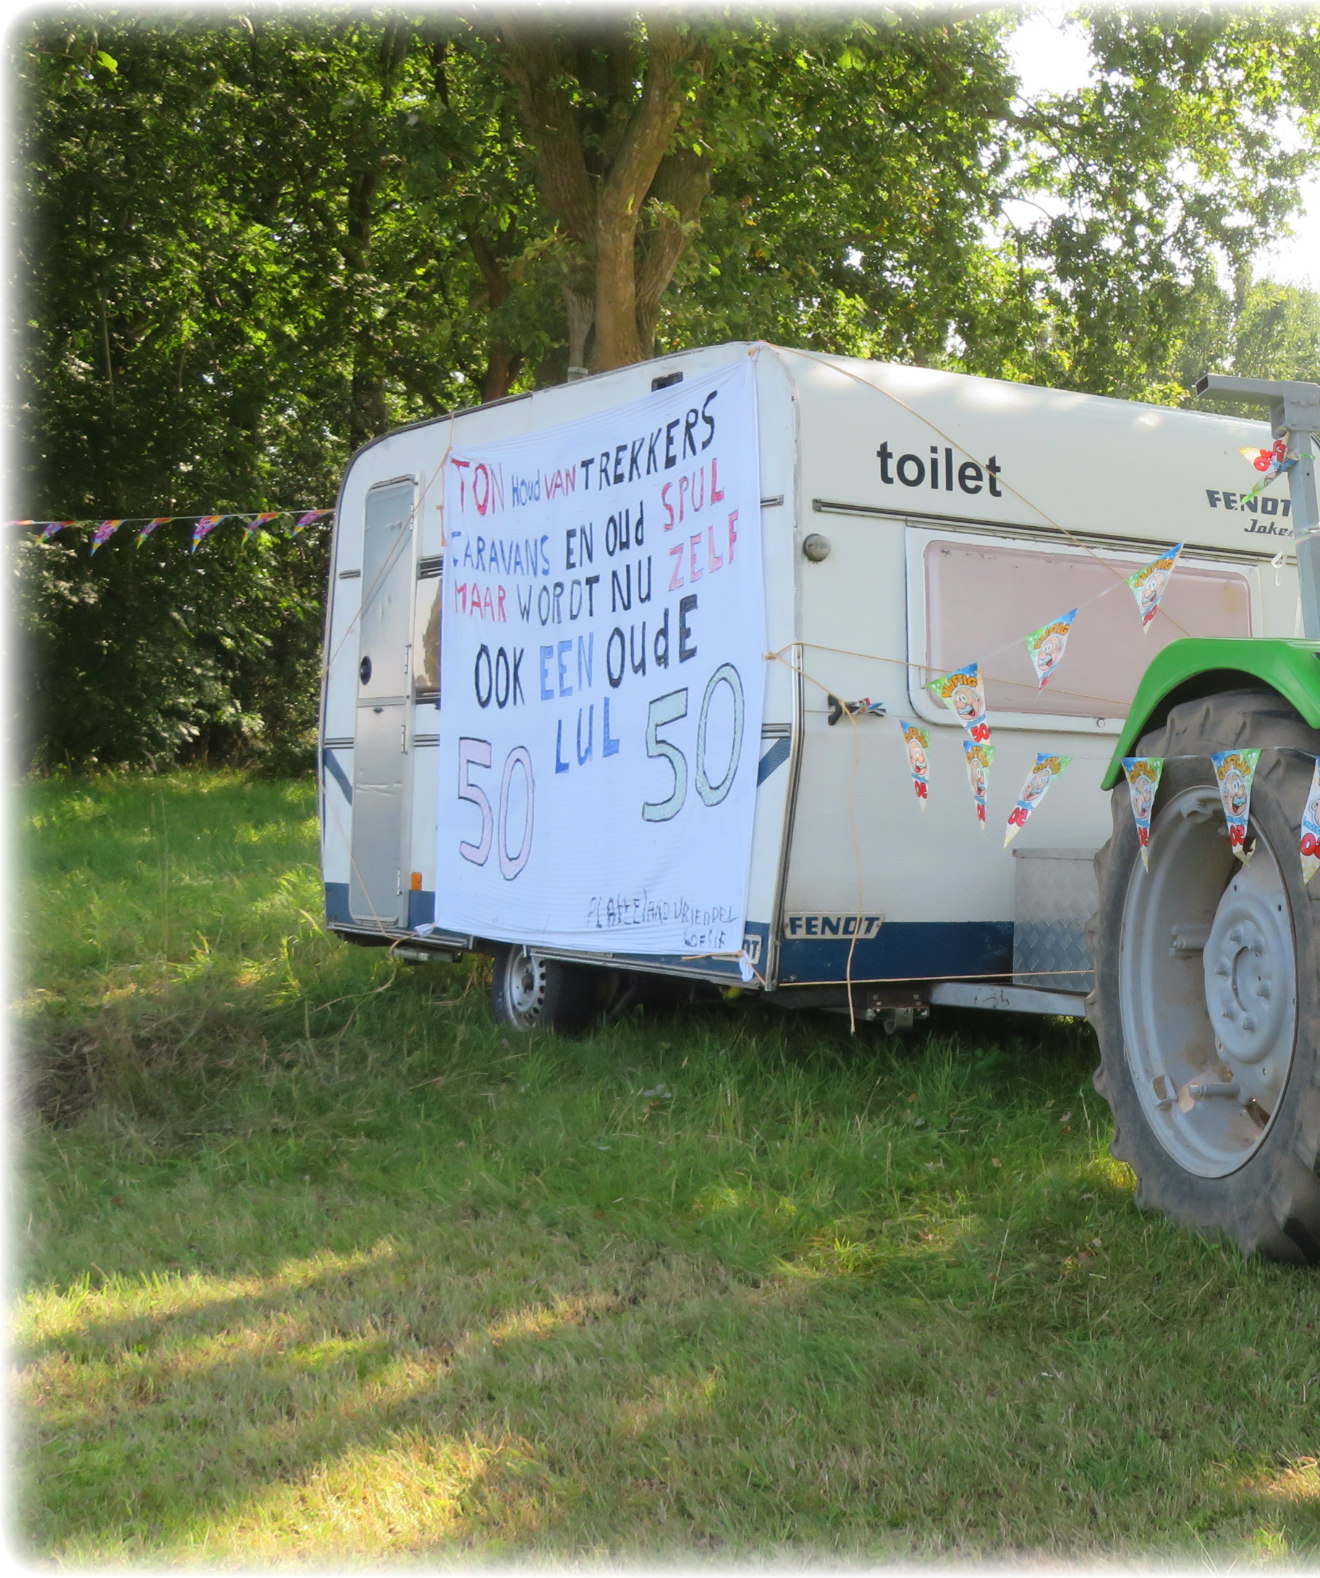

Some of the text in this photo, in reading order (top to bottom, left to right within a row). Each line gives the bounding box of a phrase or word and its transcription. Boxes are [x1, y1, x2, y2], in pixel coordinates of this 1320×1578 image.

[450, 457, 504, 516] TON
[544, 464, 577, 501] VAN
[580, 390, 718, 491] TREKKERS
[877, 442, 1002, 497] toilet
[451, 530, 551, 578] CARAVANS
[565, 522, 594, 571] EN
[661, 458, 724, 531] SPUL
[1206, 489, 1292, 517] FENDT
[454, 509, 740, 626] MAAR WORDT NU ZELF
[474, 643, 525, 709] OOK
[540, 631, 594, 701] EEN
[555, 696, 620, 775] LUL
[642, 662, 745, 822] 50
[458, 736, 536, 881] 50
[788, 915, 881, 936] FENDT
